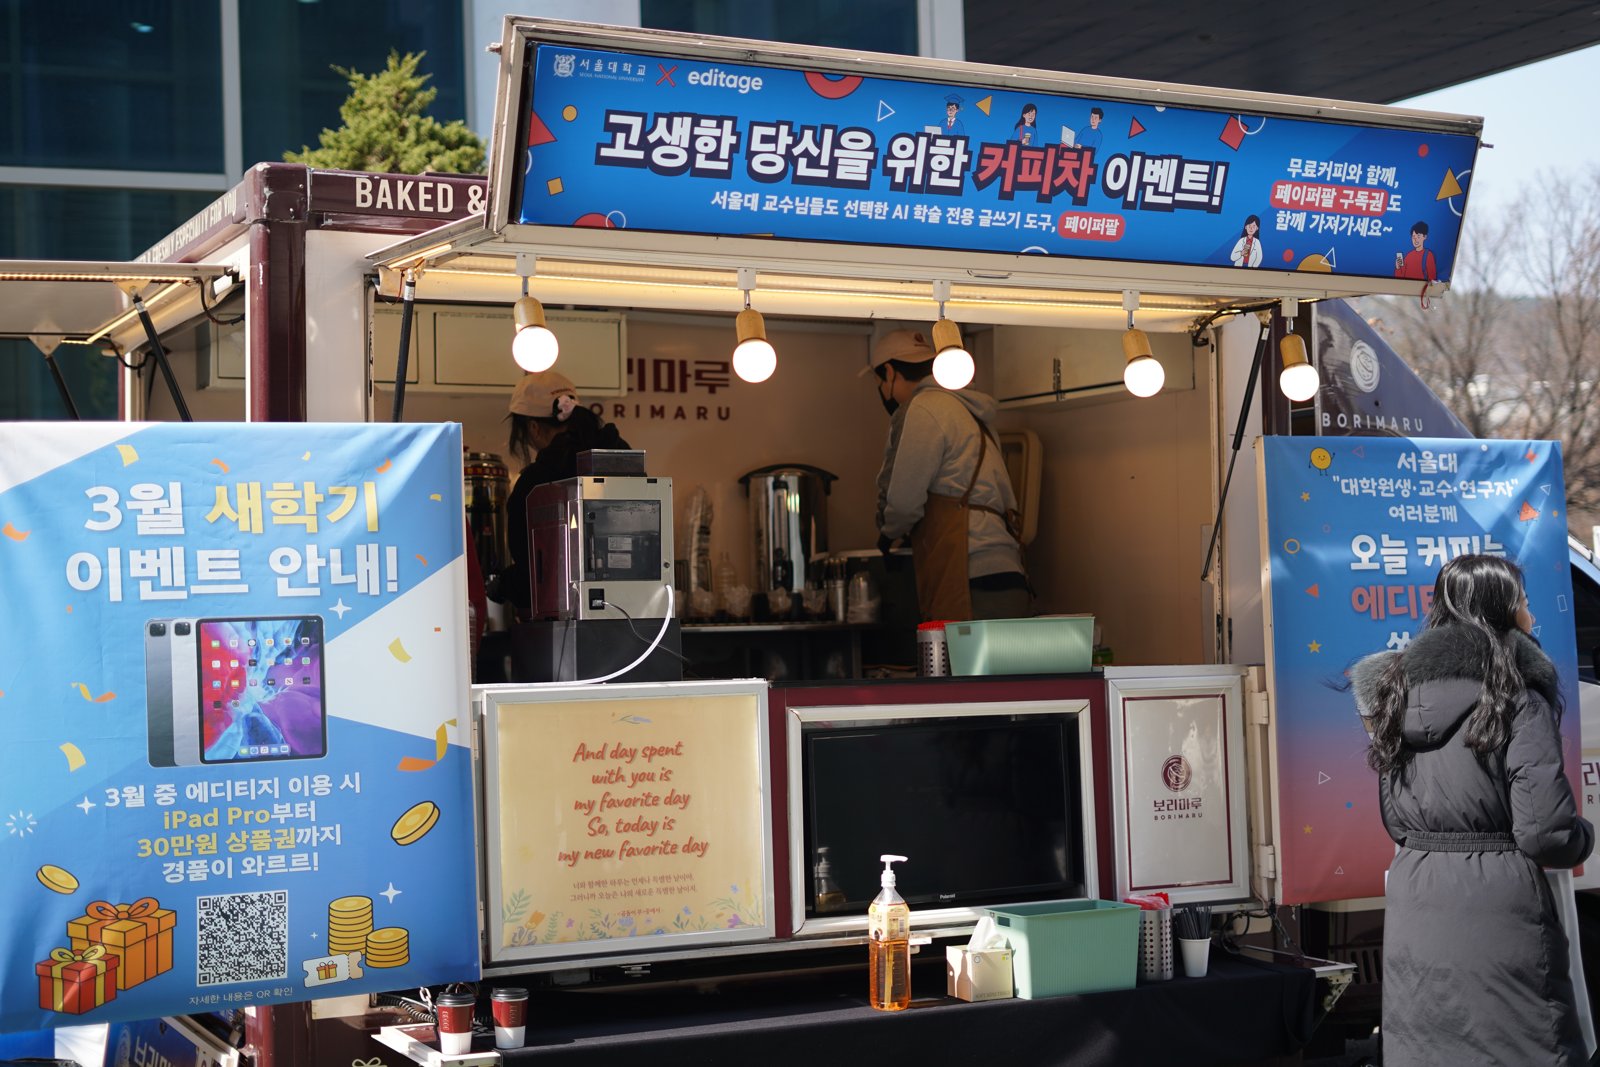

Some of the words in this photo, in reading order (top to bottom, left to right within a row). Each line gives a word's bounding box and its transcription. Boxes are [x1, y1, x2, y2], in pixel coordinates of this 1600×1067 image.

[580, 59, 646, 76] 서울대학교
[688, 68, 763, 94] editage
[598, 112, 738, 172] 고생한
[749, 122, 875, 182] 당신을
[886, 134, 970, 188] 위한
[977, 143, 1095, 199] 커피차
[1105, 154, 1226, 207] 이벤트!
[1287, 158, 1362, 184] 무료커피와
[1366, 164, 1400, 189] 함께,
[223, 189, 237, 216] YOU
[354, 177, 454, 213] BAKED
[467, 184, 486, 215] &
[1274, 183, 1337, 209] 페이퍼팔
[711, 190, 759, 212] 서울대
[762, 194, 840, 217] 교수님들도
[843, 200, 889, 220] 선택한
[892, 204, 909, 219] AI
[913, 204, 942, 224] 학술
[945, 206, 974, 226] 전용
[978, 209, 1021, 230] 글쓰기
[1023, 212, 1057, 233] 도구,
[1063, 214, 1120, 237] 페이퍼팔
[1275, 210, 1306, 232] 함께
[1309, 213, 1393, 237] 가져가세요~
[627, 357, 730, 394] 리마루
[589, 402, 731, 421] ORIMARU
[1322, 412, 1423, 432] BORIMARU
[1397, 451, 1458, 474] 서울대
[83, 481, 186, 535] 3월
[204, 480, 379, 534] 새학기
[1388, 504, 1458, 524] 여러분께
[1350, 534, 1408, 576] 오늘
[65, 545, 249, 602] 이벤트
[268, 542, 399, 598] 안내!
[572, 742, 608, 763] And
[609, 742, 637, 764] day
[641, 740, 684, 763] spent
[104, 784, 146, 808] 3월
[153, 783, 178, 806] 중
[185, 777, 280, 803] 에디티지
[288, 773, 333, 797] 이용
[339, 771, 362, 793] 시
[591, 766, 626, 785] with
[627, 771, 656, 788] you
[659, 766, 674, 782] is
[163, 807, 219, 829] iPad
[227, 800, 317, 826] Pro부터
[573, 798, 596, 816] my
[599, 791, 661, 812] favorite
[663, 788, 691, 810] day
[1153, 797, 1202, 812] 보리마루
[587, 815, 609, 837] So,
[615, 815, 659, 837] today
[662, 815, 677, 831] is
[1154, 812, 1203, 821] BORIMARU
[136, 832, 218, 858] 30만원
[225, 824, 342, 854] 상품권까지
[557, 848, 581, 867] my
[583, 847, 615, 860] new
[618, 840, 679, 861] favorite
[681, 836, 709, 858] day
[161, 857, 234, 884] 경품이
[241, 852, 319, 877] 와르르!
[188, 993, 220, 1006] 자세한
[223, 990, 254, 1003] 내용은
[256, 989, 271, 999] QR
[273, 986, 294, 998] 확인
